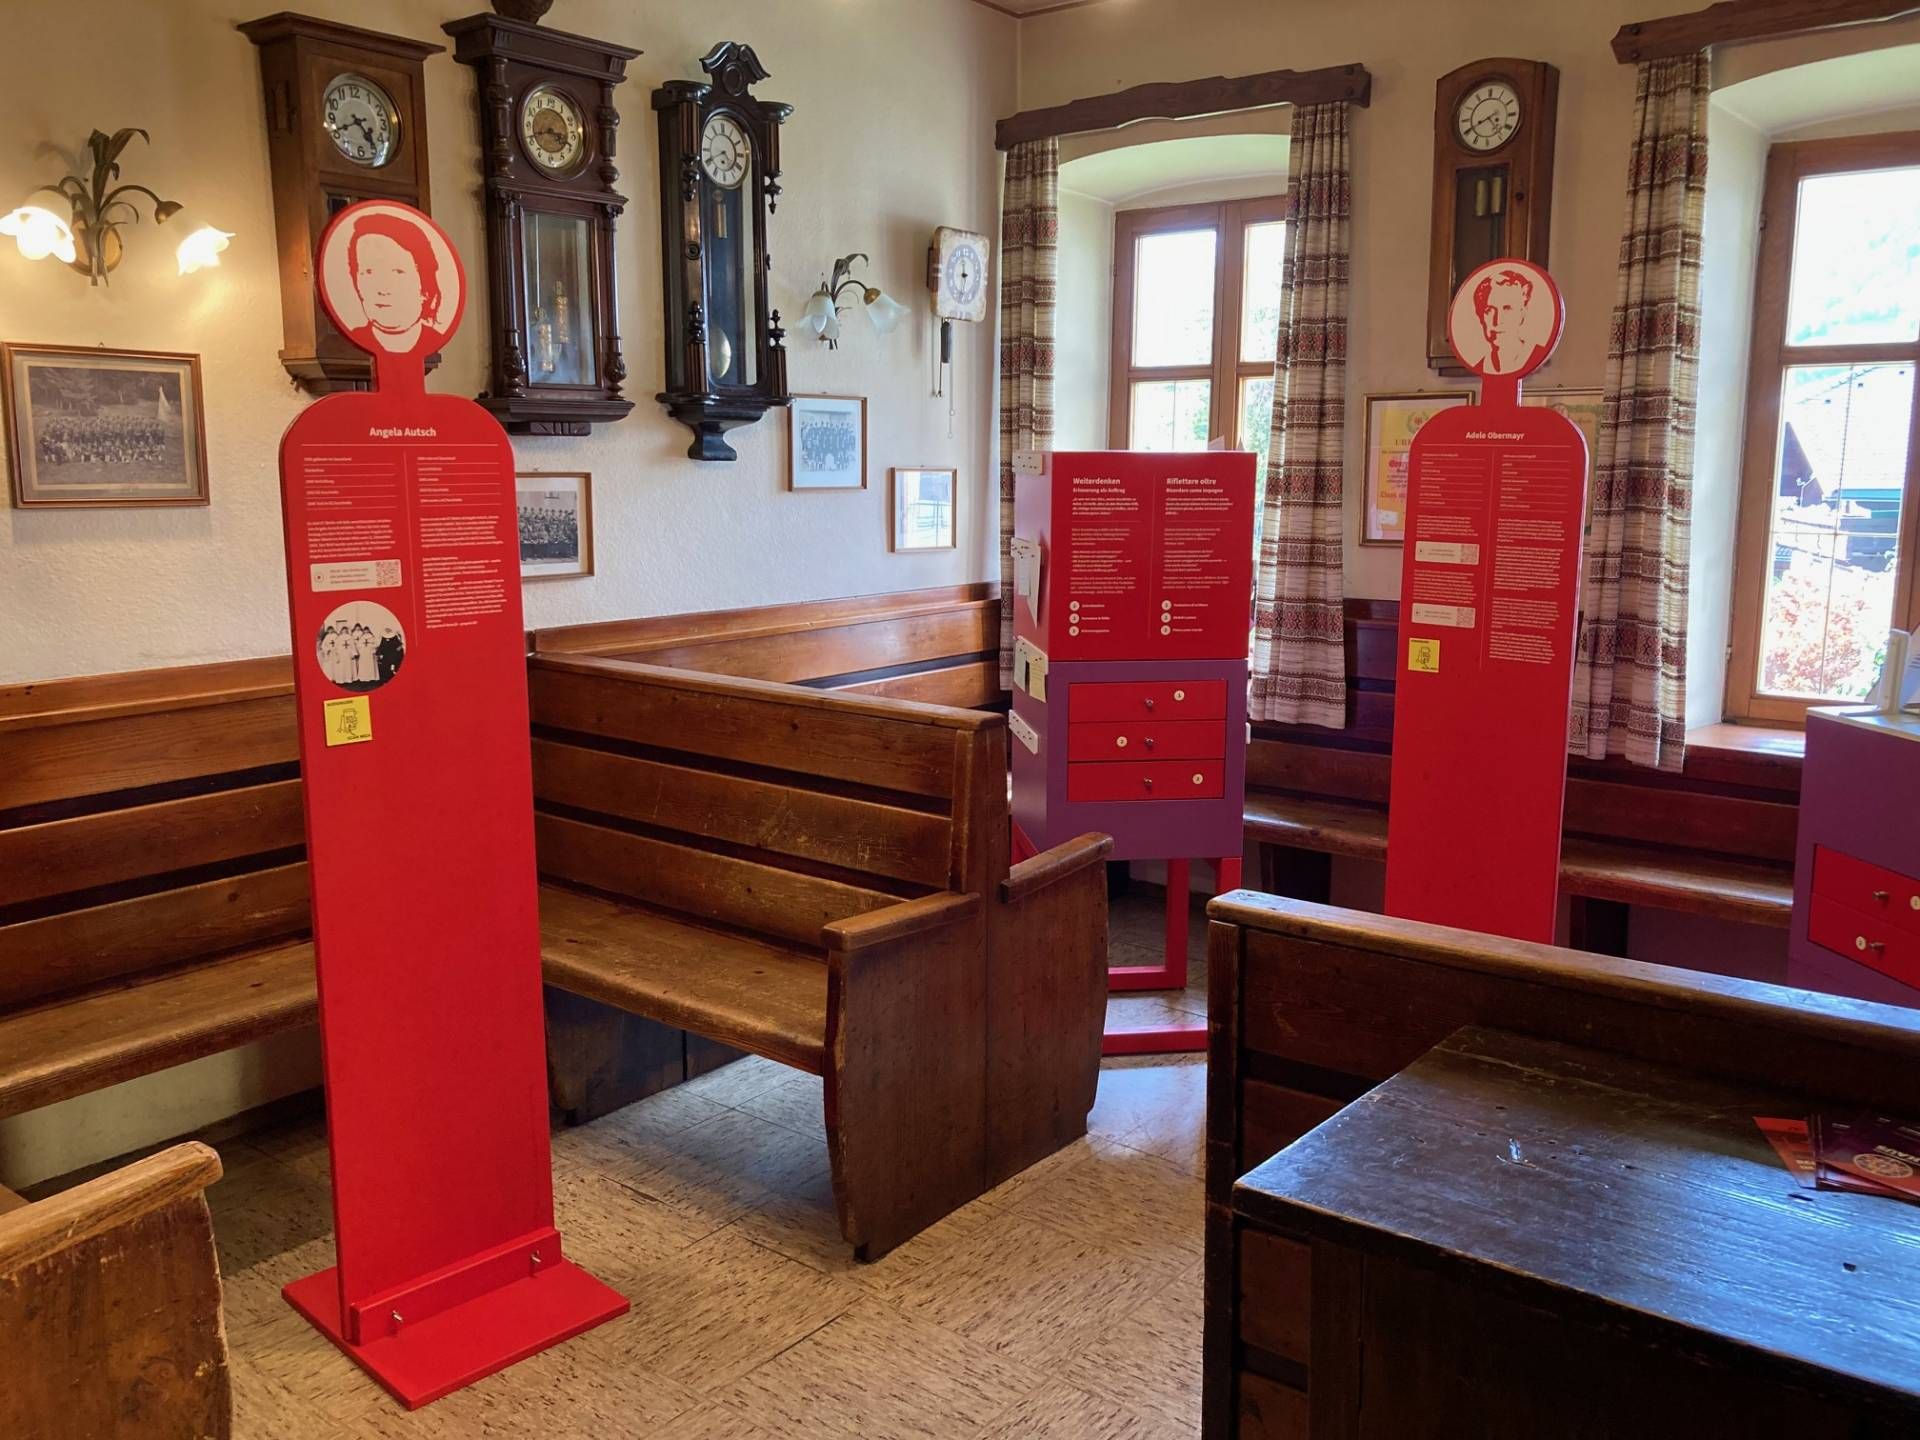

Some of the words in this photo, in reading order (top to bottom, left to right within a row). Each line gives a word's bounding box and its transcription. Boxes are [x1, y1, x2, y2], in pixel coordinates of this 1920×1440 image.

[338, 87, 345, 100] 11
[349, 86, 360, 99] 12
[329, 98, 338, 111] 10
[367, 94, 371, 104] 1
[376, 104, 384, 116] 2
[328, 112, 336, 124] 9
[380, 119, 387, 131] 3
[357, 146, 365, 157] 6
[369, 427, 402, 439] Angela
[404, 427, 437, 436] Autsch
[1487, 432, 1524, 441] Obermayr
